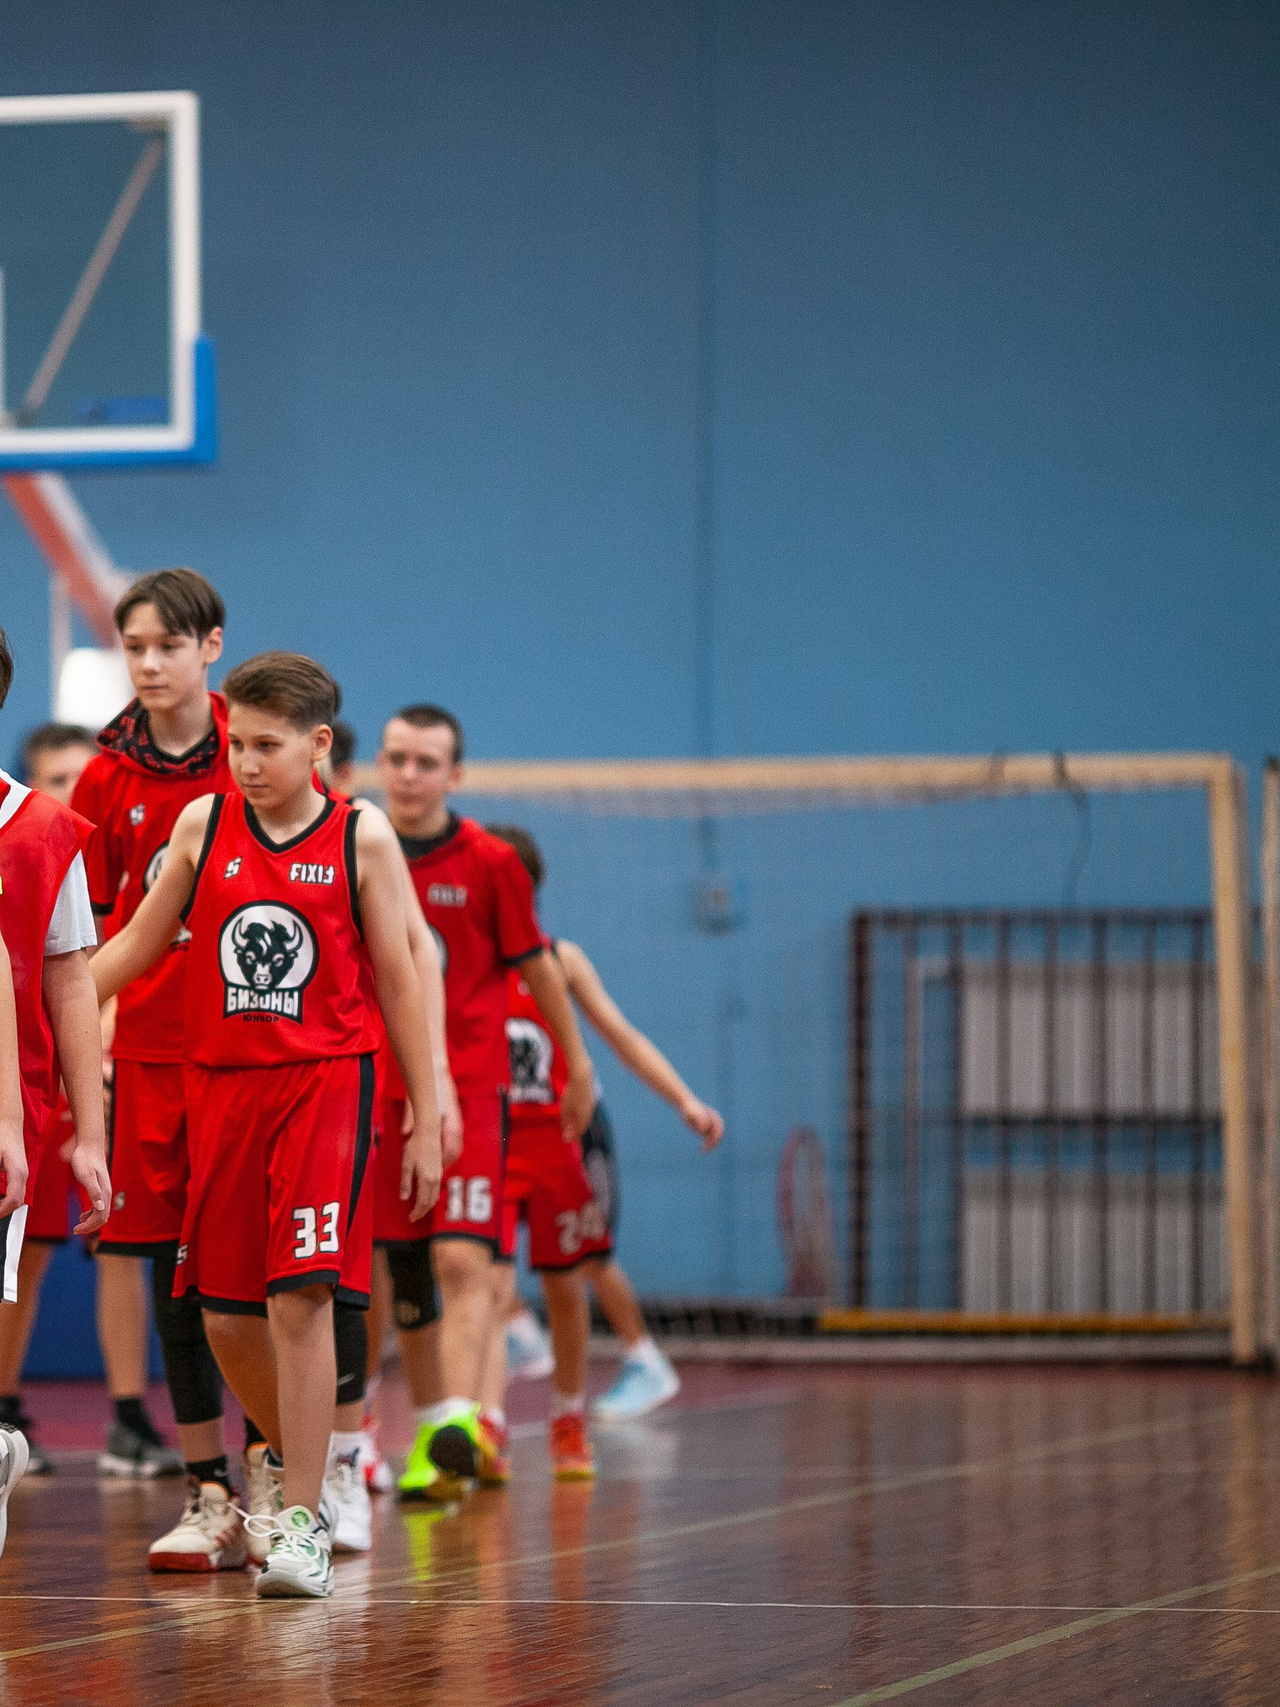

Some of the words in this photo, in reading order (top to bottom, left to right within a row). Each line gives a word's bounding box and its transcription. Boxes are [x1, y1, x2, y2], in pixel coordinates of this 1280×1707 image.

[227, 986, 299, 1016] БИЗОНЫ
[444, 1175, 493, 1223] 16
[291, 1201, 341, 1259] 33
